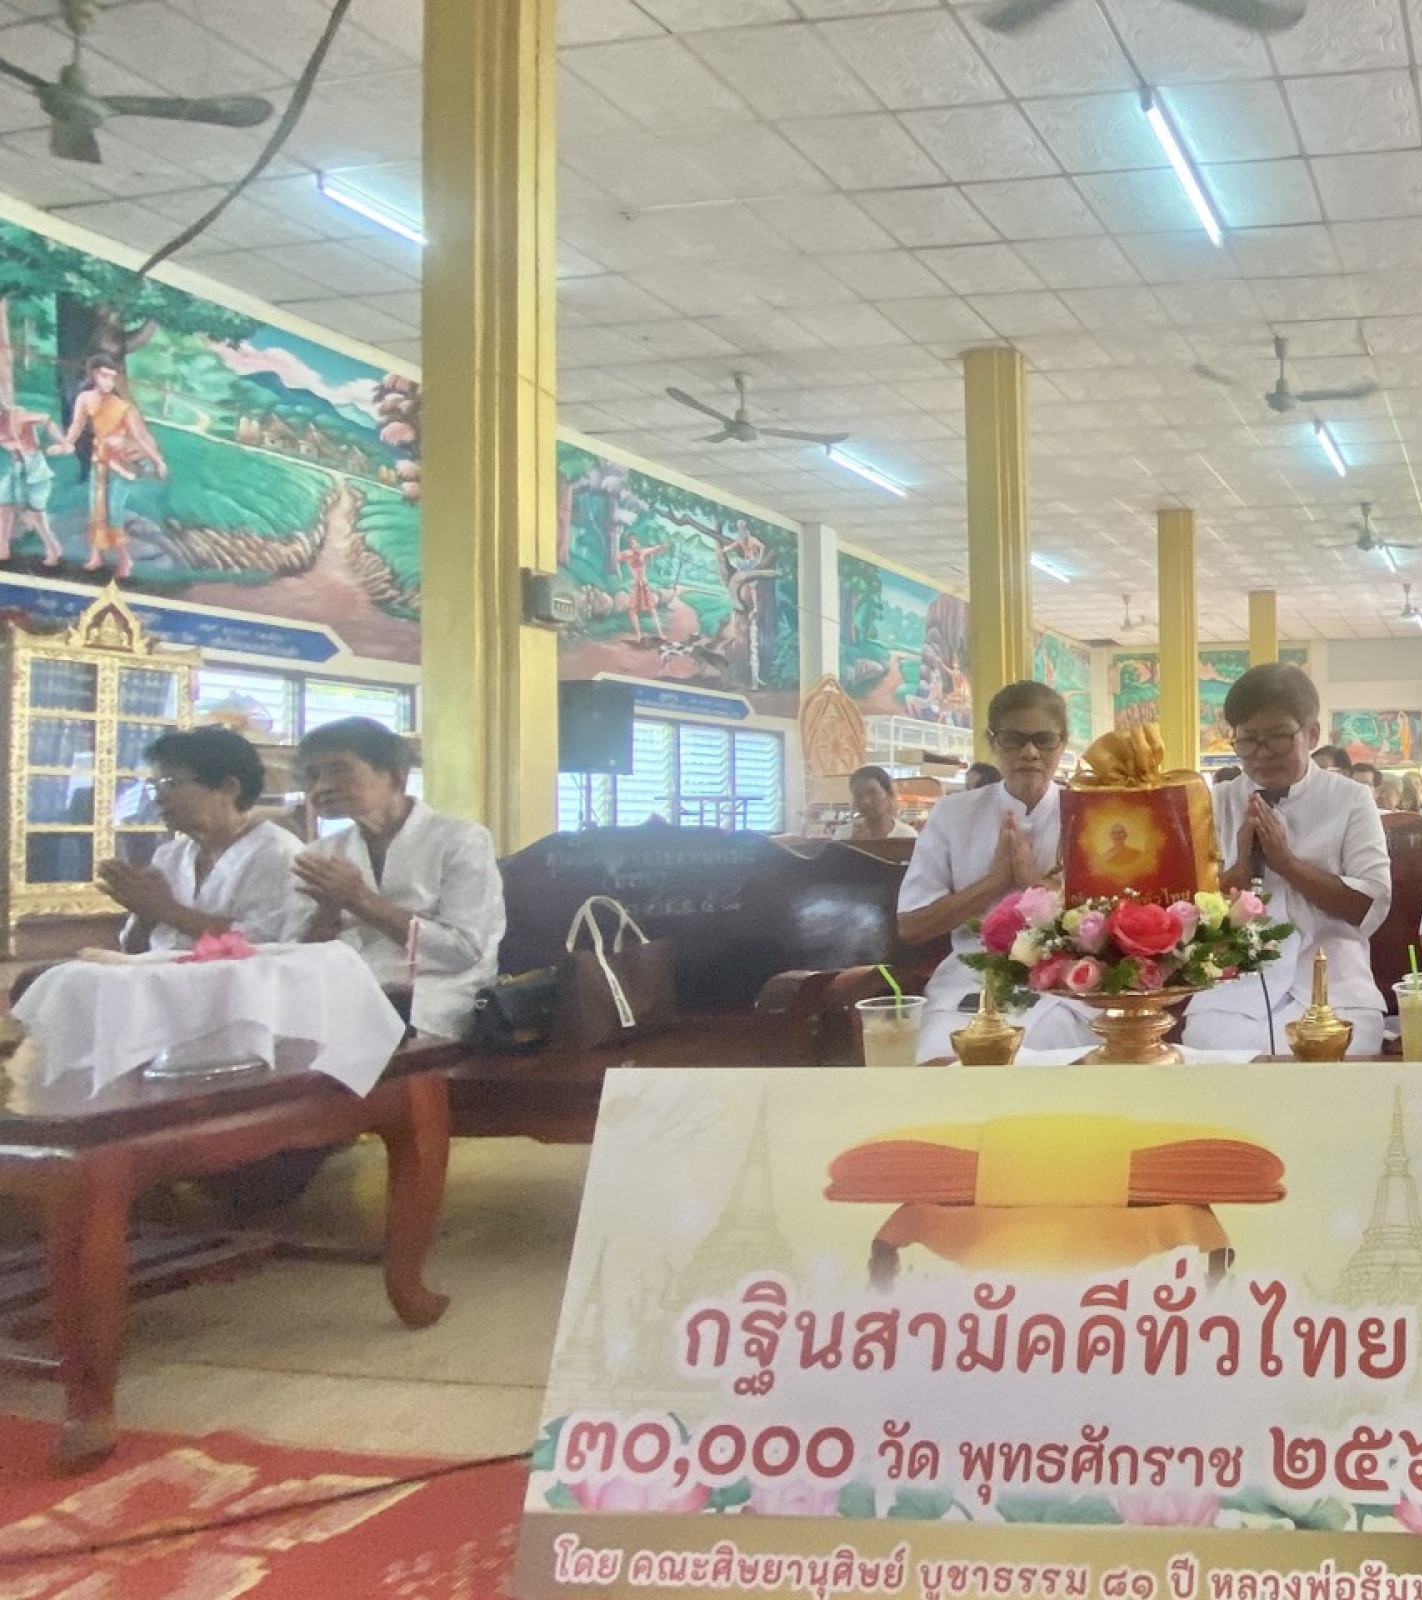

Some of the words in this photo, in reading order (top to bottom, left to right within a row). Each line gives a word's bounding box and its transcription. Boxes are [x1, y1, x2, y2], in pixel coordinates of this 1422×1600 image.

[684, 1258, 1408, 1396] กฐินสามัคคีทั่วไทย
[564, 1421, 855, 1486] ๓๐,๐๐๐
[878, 1420, 941, 1482] วัด
[957, 1424, 1244, 1505] พุทธศักราช
[556, 1539, 619, 1578] โดย
[631, 1544, 906, 1598] คณะศิษยานุศิษย์
[919, 1563, 1088, 1600] บูชาธรรม
[1102, 1571, 1155, 1599] ๘๑
[1171, 1557, 1196, 1598] ปี
